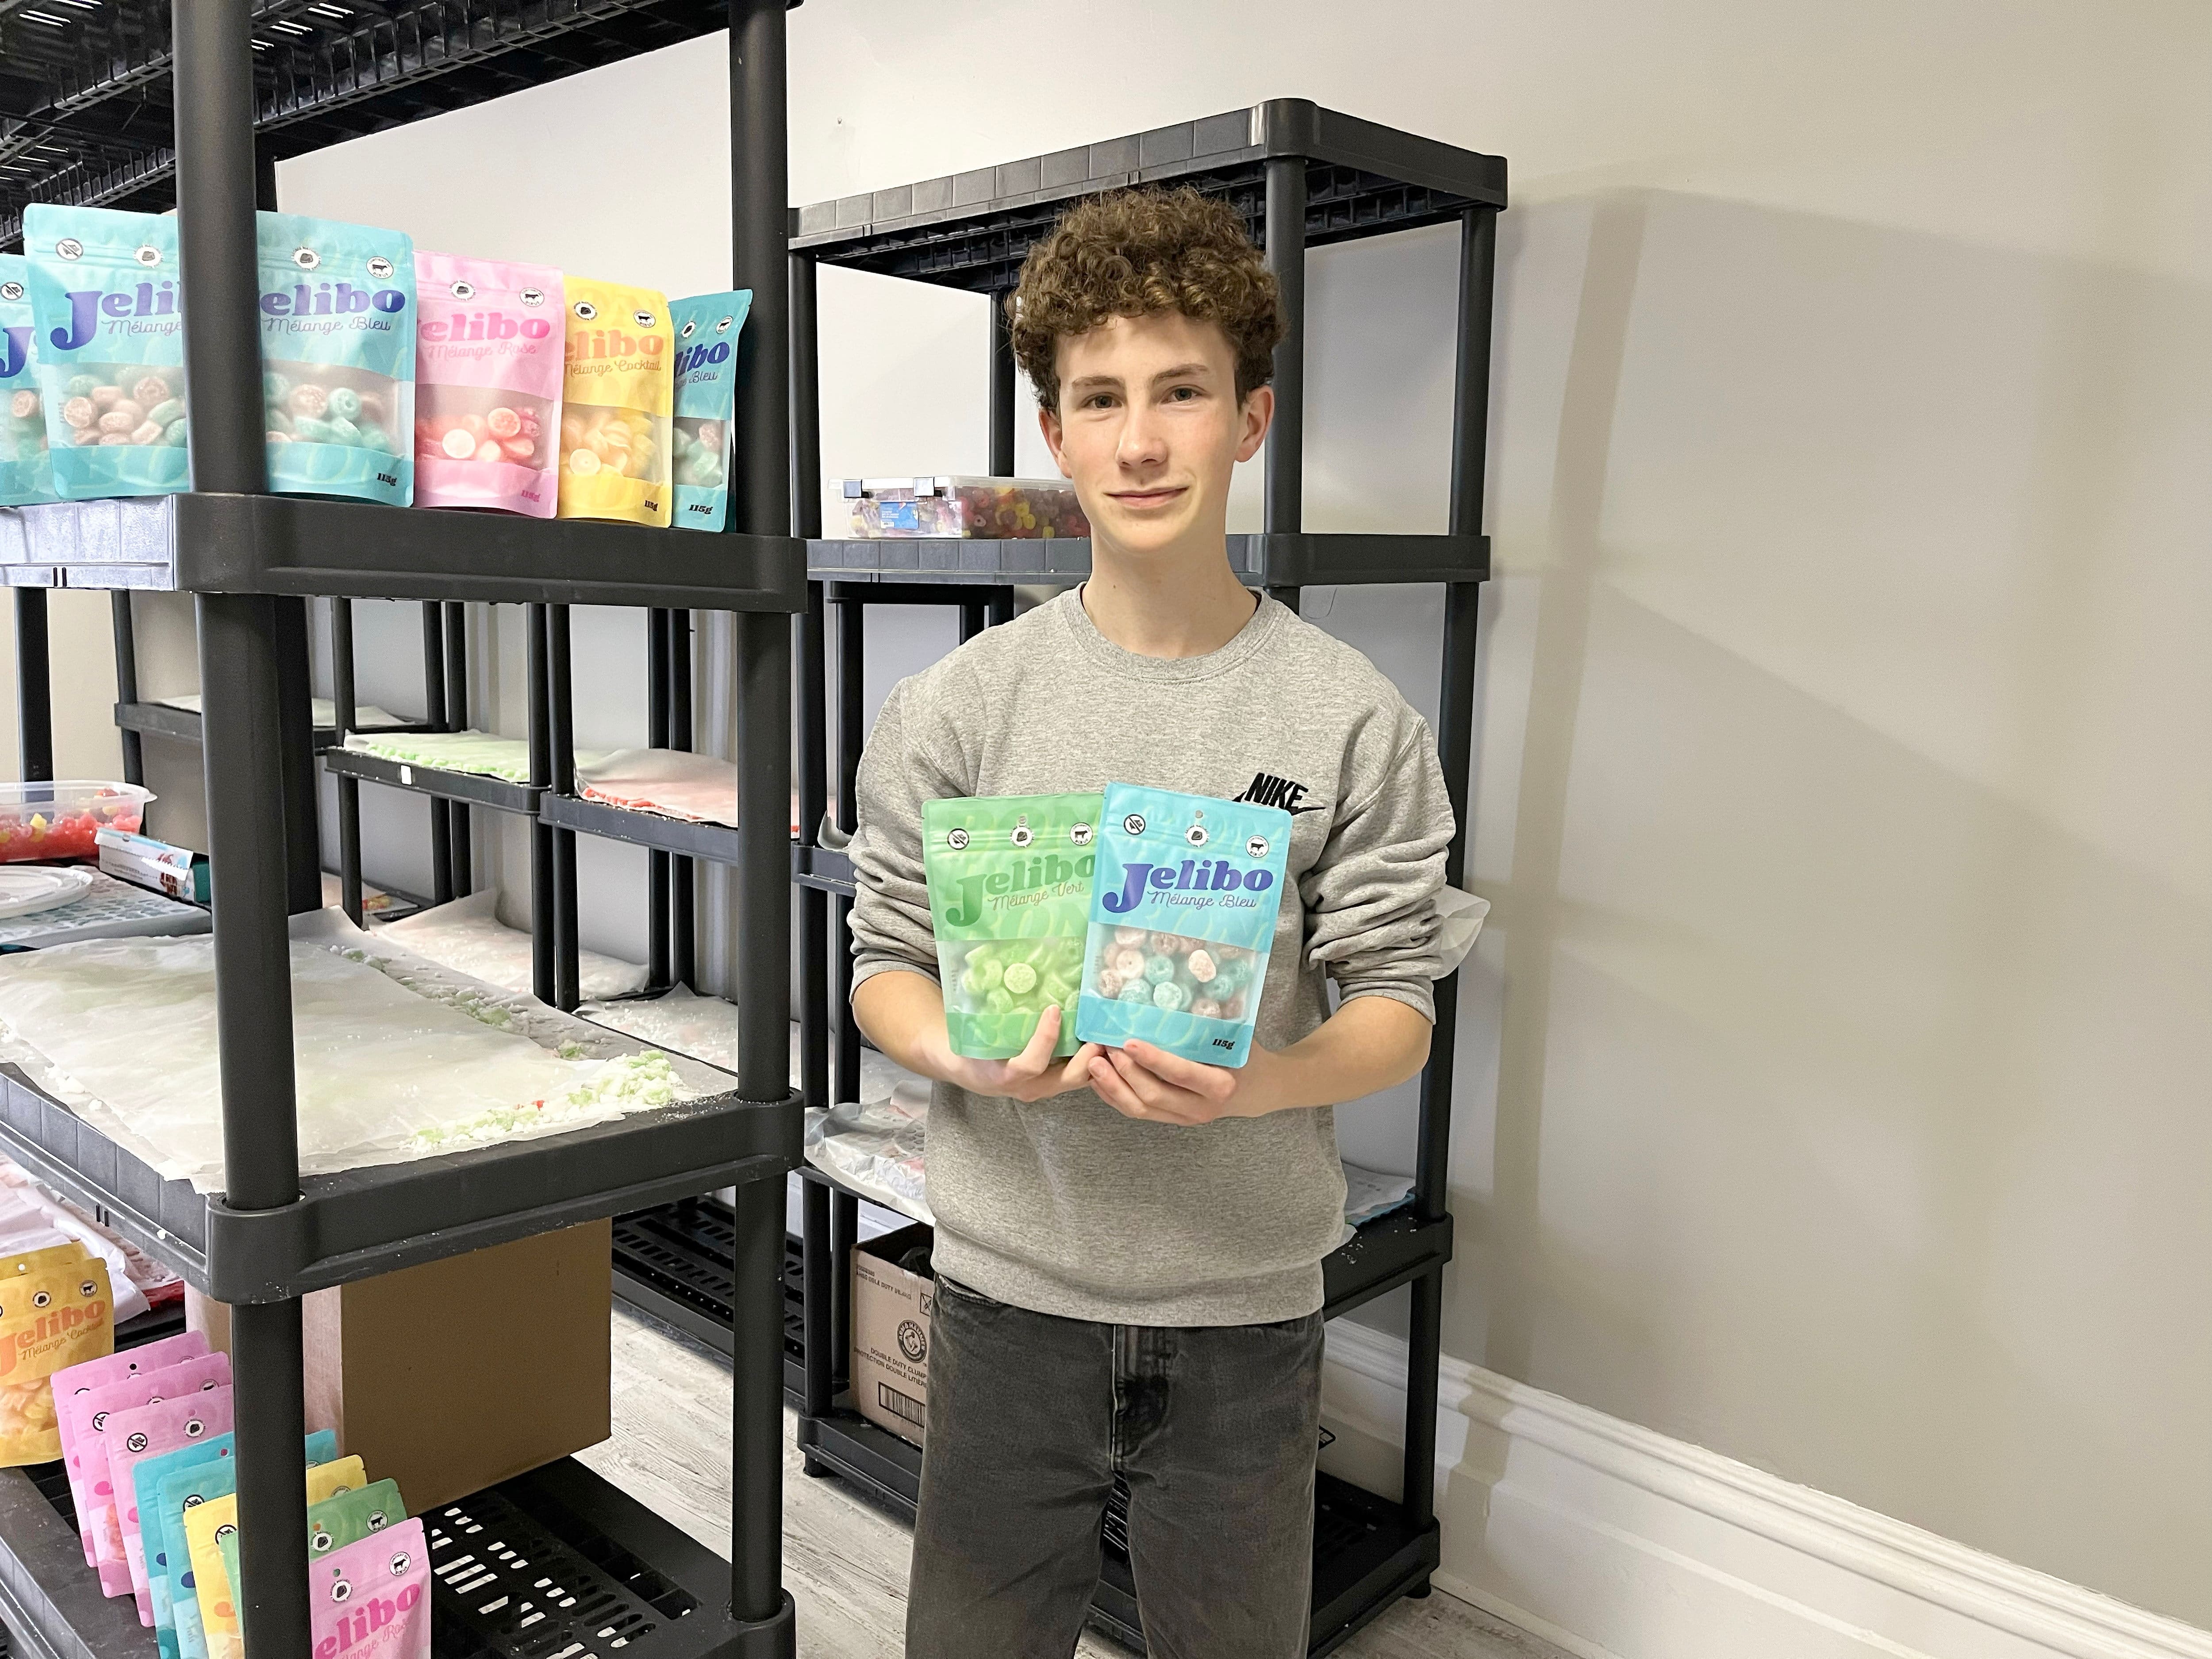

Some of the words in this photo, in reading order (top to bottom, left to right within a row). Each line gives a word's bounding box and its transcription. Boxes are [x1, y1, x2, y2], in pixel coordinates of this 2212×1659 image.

[260, 282, 406, 316] elibo
[50, 280, 181, 350] Jeli
[261, 318, 344, 335] Mélange
[349, 316, 391, 331] Bleu
[419, 312, 550, 342] elibo
[423, 345, 493, 361] Mélange
[498, 342, 538, 355] Rose
[565, 329, 664, 361] libo
[674, 342, 730, 377] libo
[614, 359, 662, 372] Cocktail
[689, 370, 718, 384] Bleu
[377, 472, 397, 487] 115g
[644, 500, 658, 511] 115g
[688, 504, 713, 515] 115g
[1244, 772, 1309, 810] NIKE
[945, 854, 1095, 927] Jelibo
[987, 889, 1049, 910] Mélange
[1052, 880, 1084, 897] Vert
[1102, 860, 1273, 913] Jelibo
[1147, 890, 1214, 910] Mélange
[1219, 894, 1256, 908] Bleu
[1212, 1038, 1235, 1050] 115g
[315, 1583, 420, 1659] elibo
